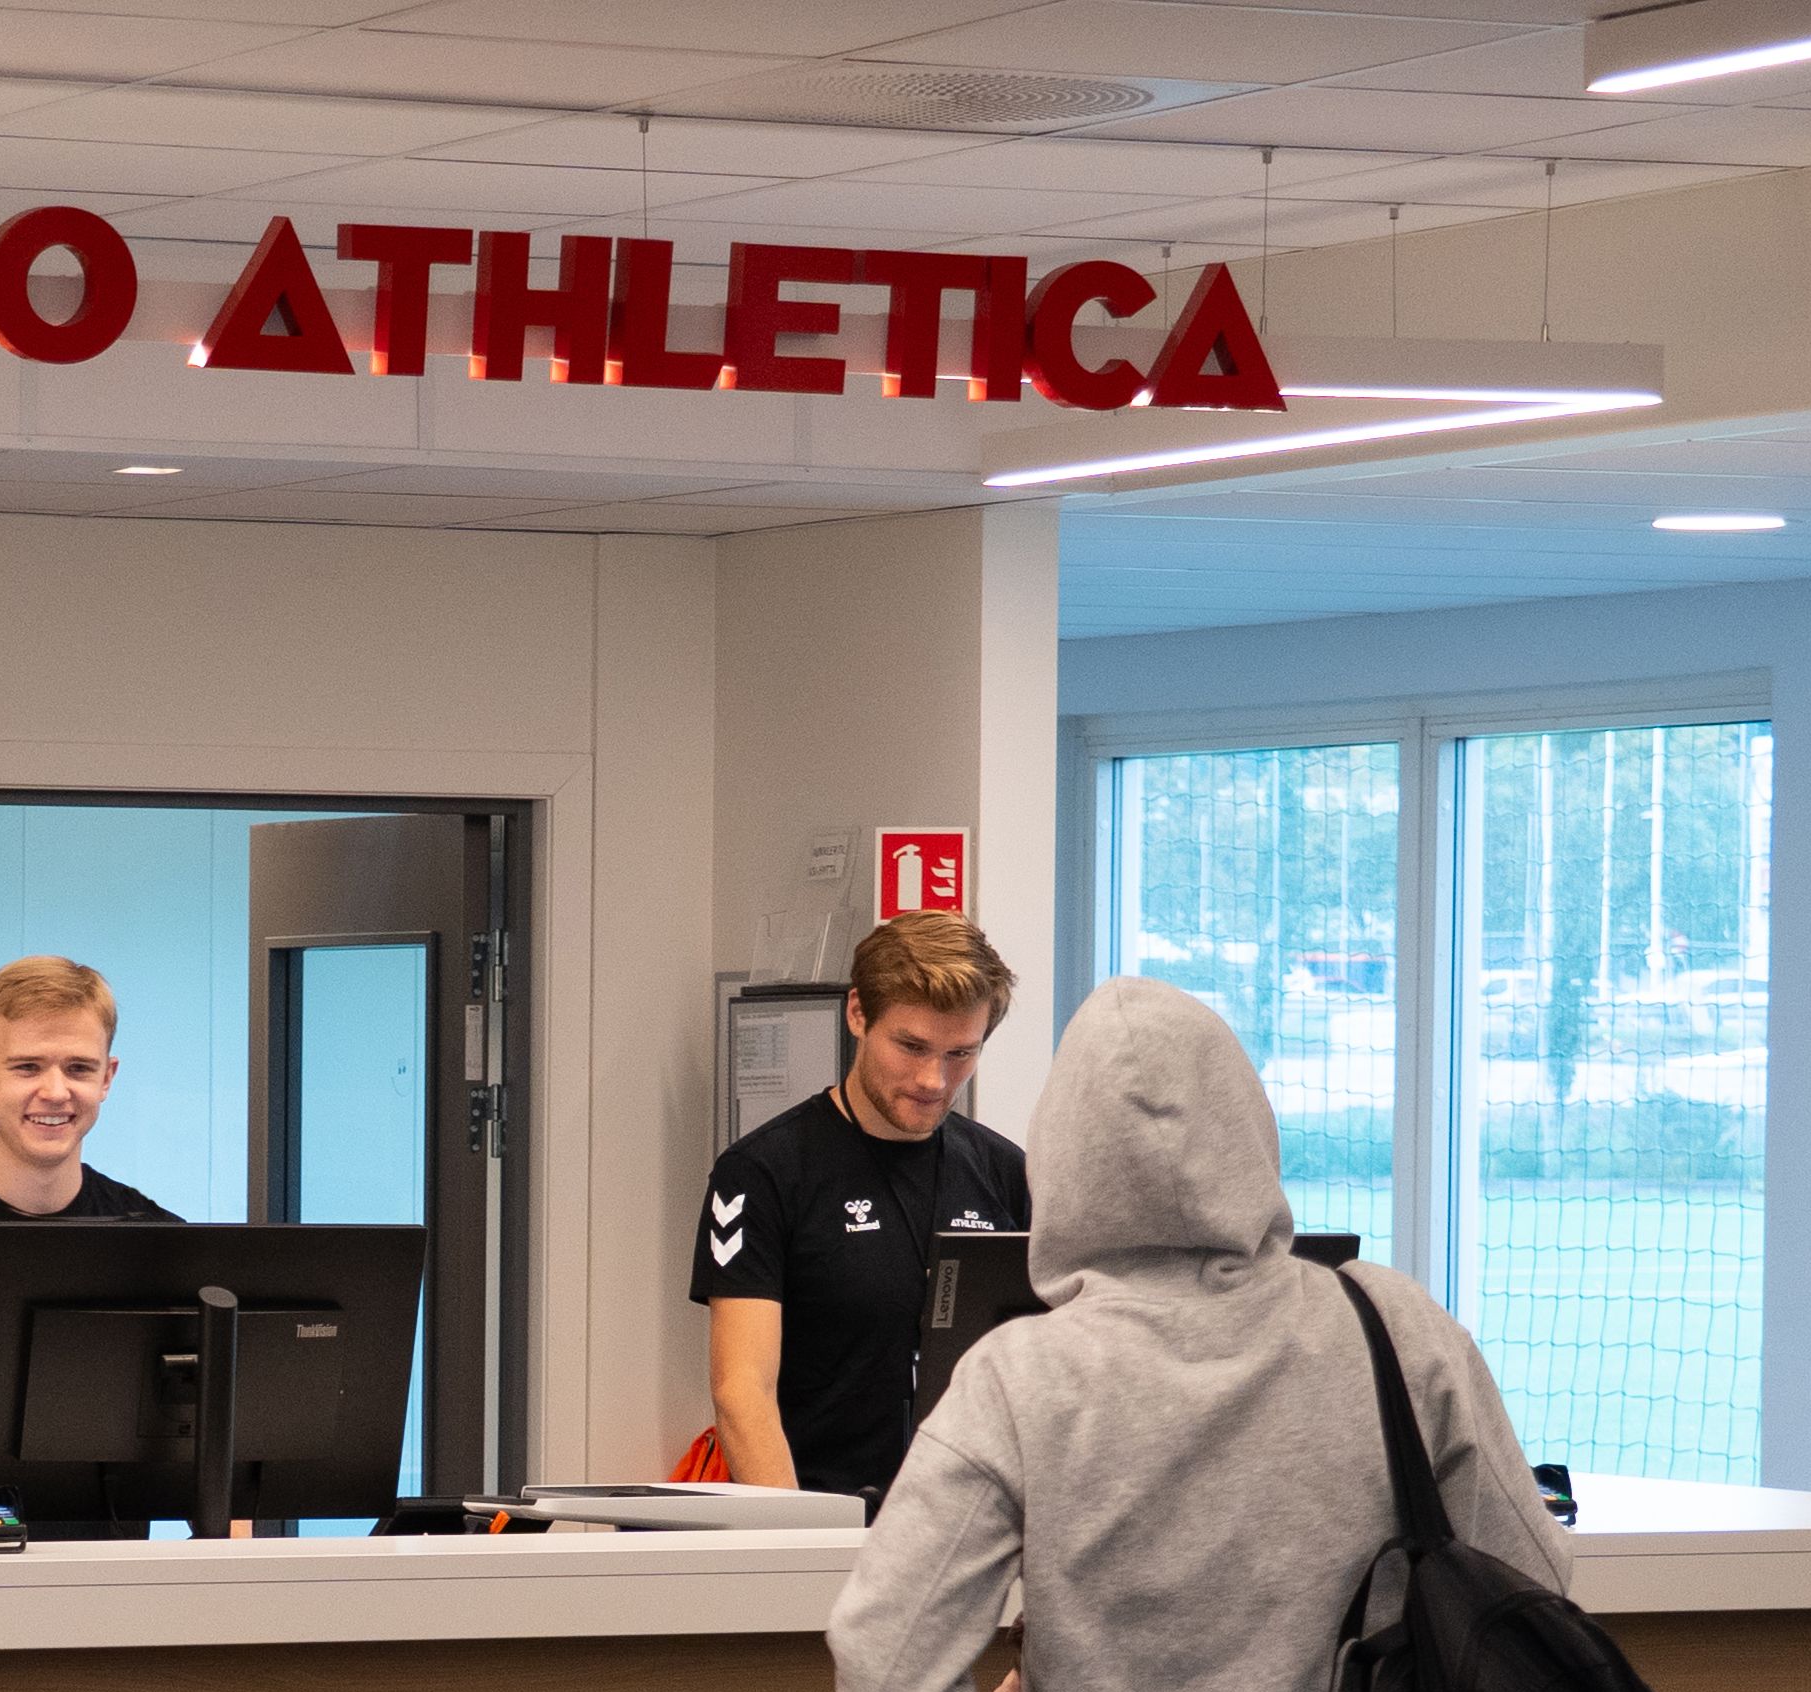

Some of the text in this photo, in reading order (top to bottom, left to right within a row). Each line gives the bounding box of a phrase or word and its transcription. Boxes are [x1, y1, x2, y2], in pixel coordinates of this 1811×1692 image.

[190, 215, 1287, 412] ATHLETICA
[950, 1219, 995, 1231] ATHLETICA
[936, 1265, 954, 1322] Lenovo
